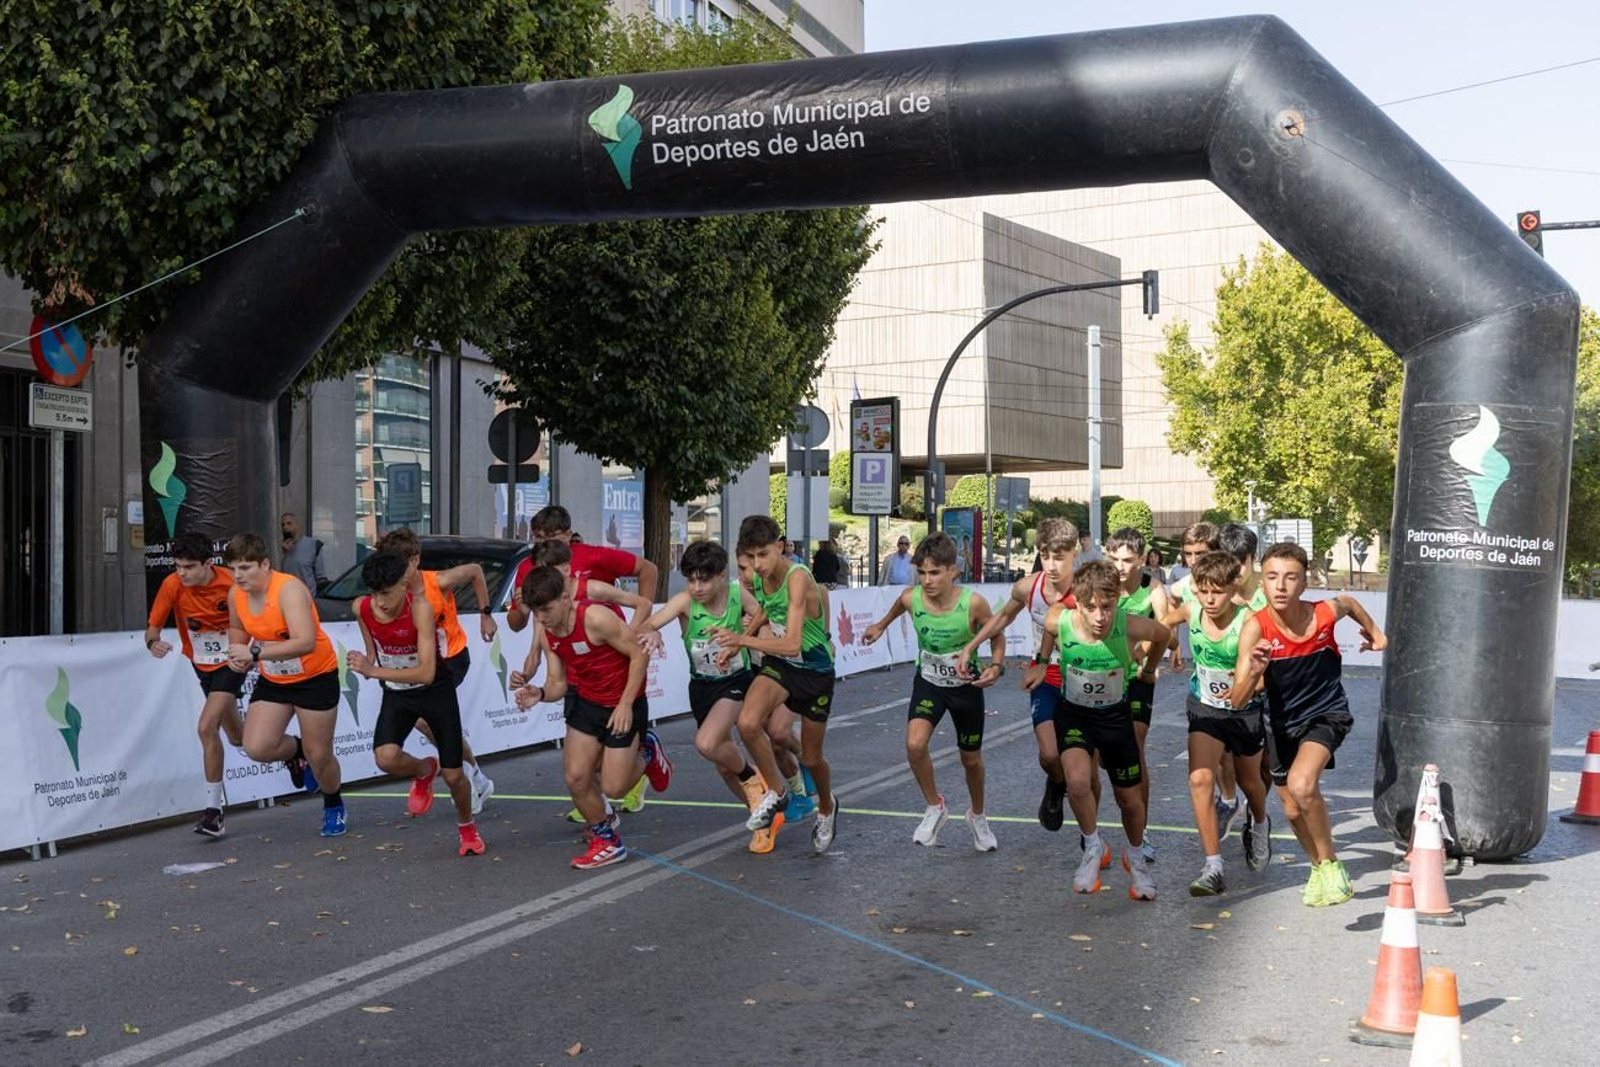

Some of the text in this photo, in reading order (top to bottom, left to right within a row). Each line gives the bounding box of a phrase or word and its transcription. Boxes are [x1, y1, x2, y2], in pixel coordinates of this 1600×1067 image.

[651, 92, 931, 136] Patronato Municipal de
[652, 126, 866, 168] Deportes de Jaén
[866, 461, 881, 482] P
[603, 482, 641, 511] Entra
[1408, 529, 1555, 551] Patronato Municipal de
[1420, 545, 1541, 567] Deportes de Jaén
[205, 642, 221, 652] 53
[931, 663, 957, 676] 169
[1083, 683, 1105, 694] 92
[335, 744, 365, 757] Deportes
[34, 770, 128, 795] Patronato Municipal de
[226, 764, 259, 780] CIUDAD
[260, 763, 274, 775] DE
[47, 785, 120, 808] Deportes de Jaén
